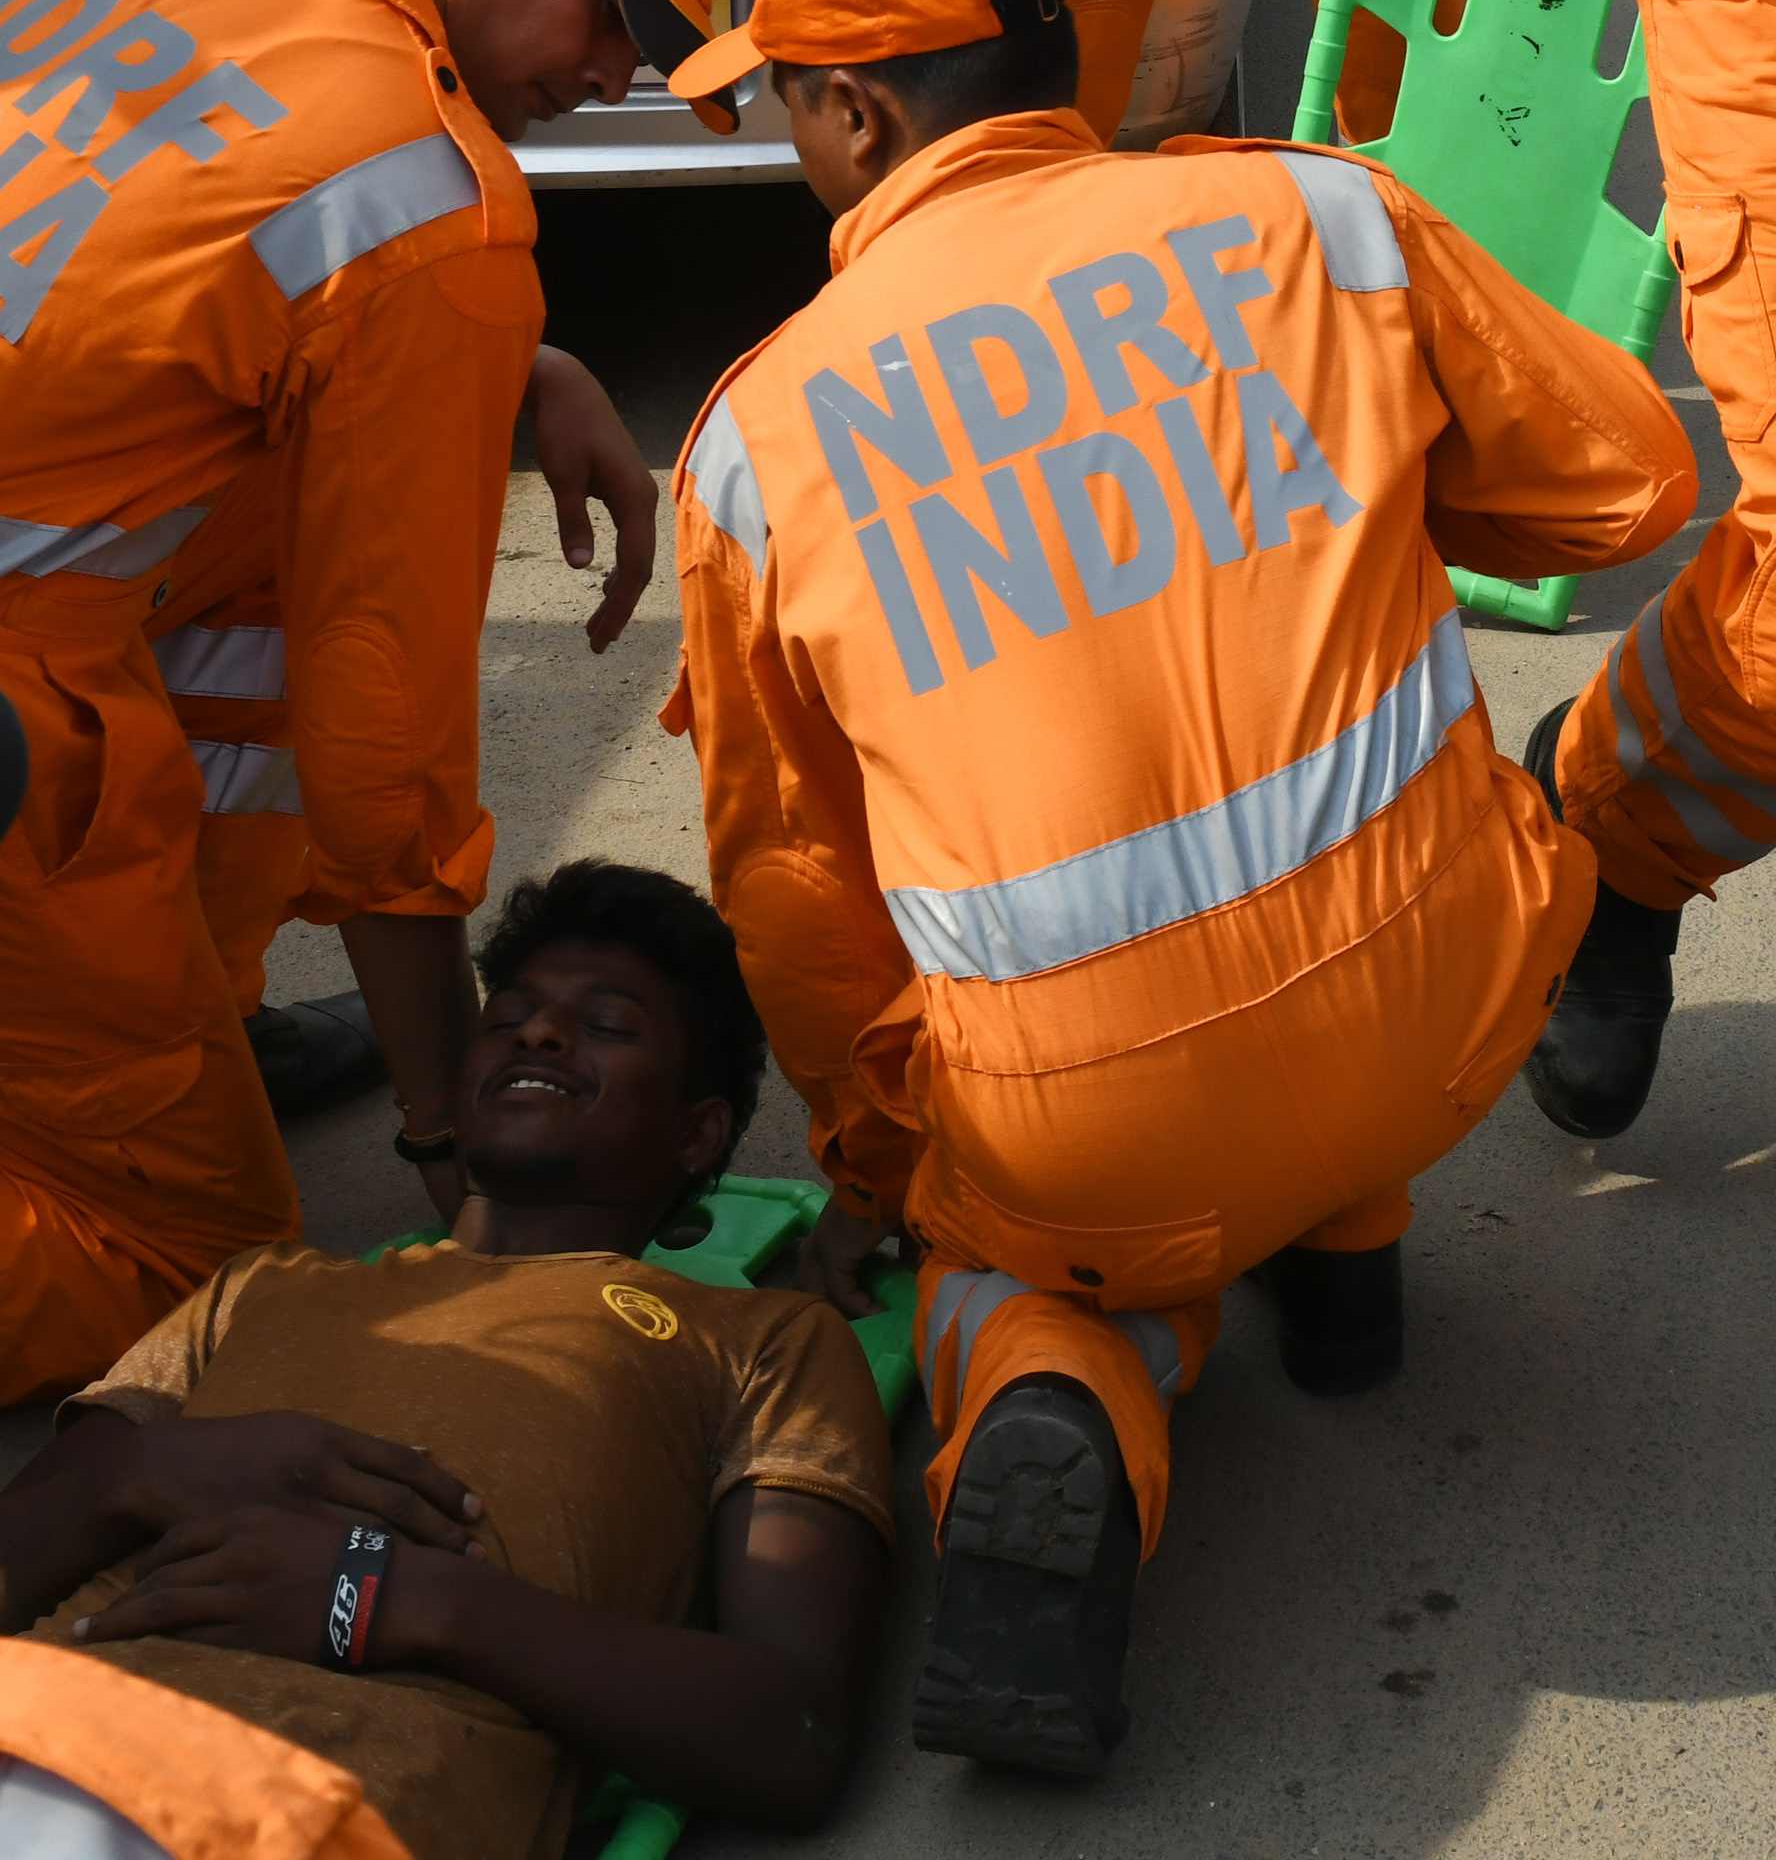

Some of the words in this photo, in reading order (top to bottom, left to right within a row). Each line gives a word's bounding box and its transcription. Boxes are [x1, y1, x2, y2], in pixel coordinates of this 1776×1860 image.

[802, 212, 1275, 525] NDRF
[855, 367, 1363, 698] INDIA
[328, 1574, 358, 1657] 46
